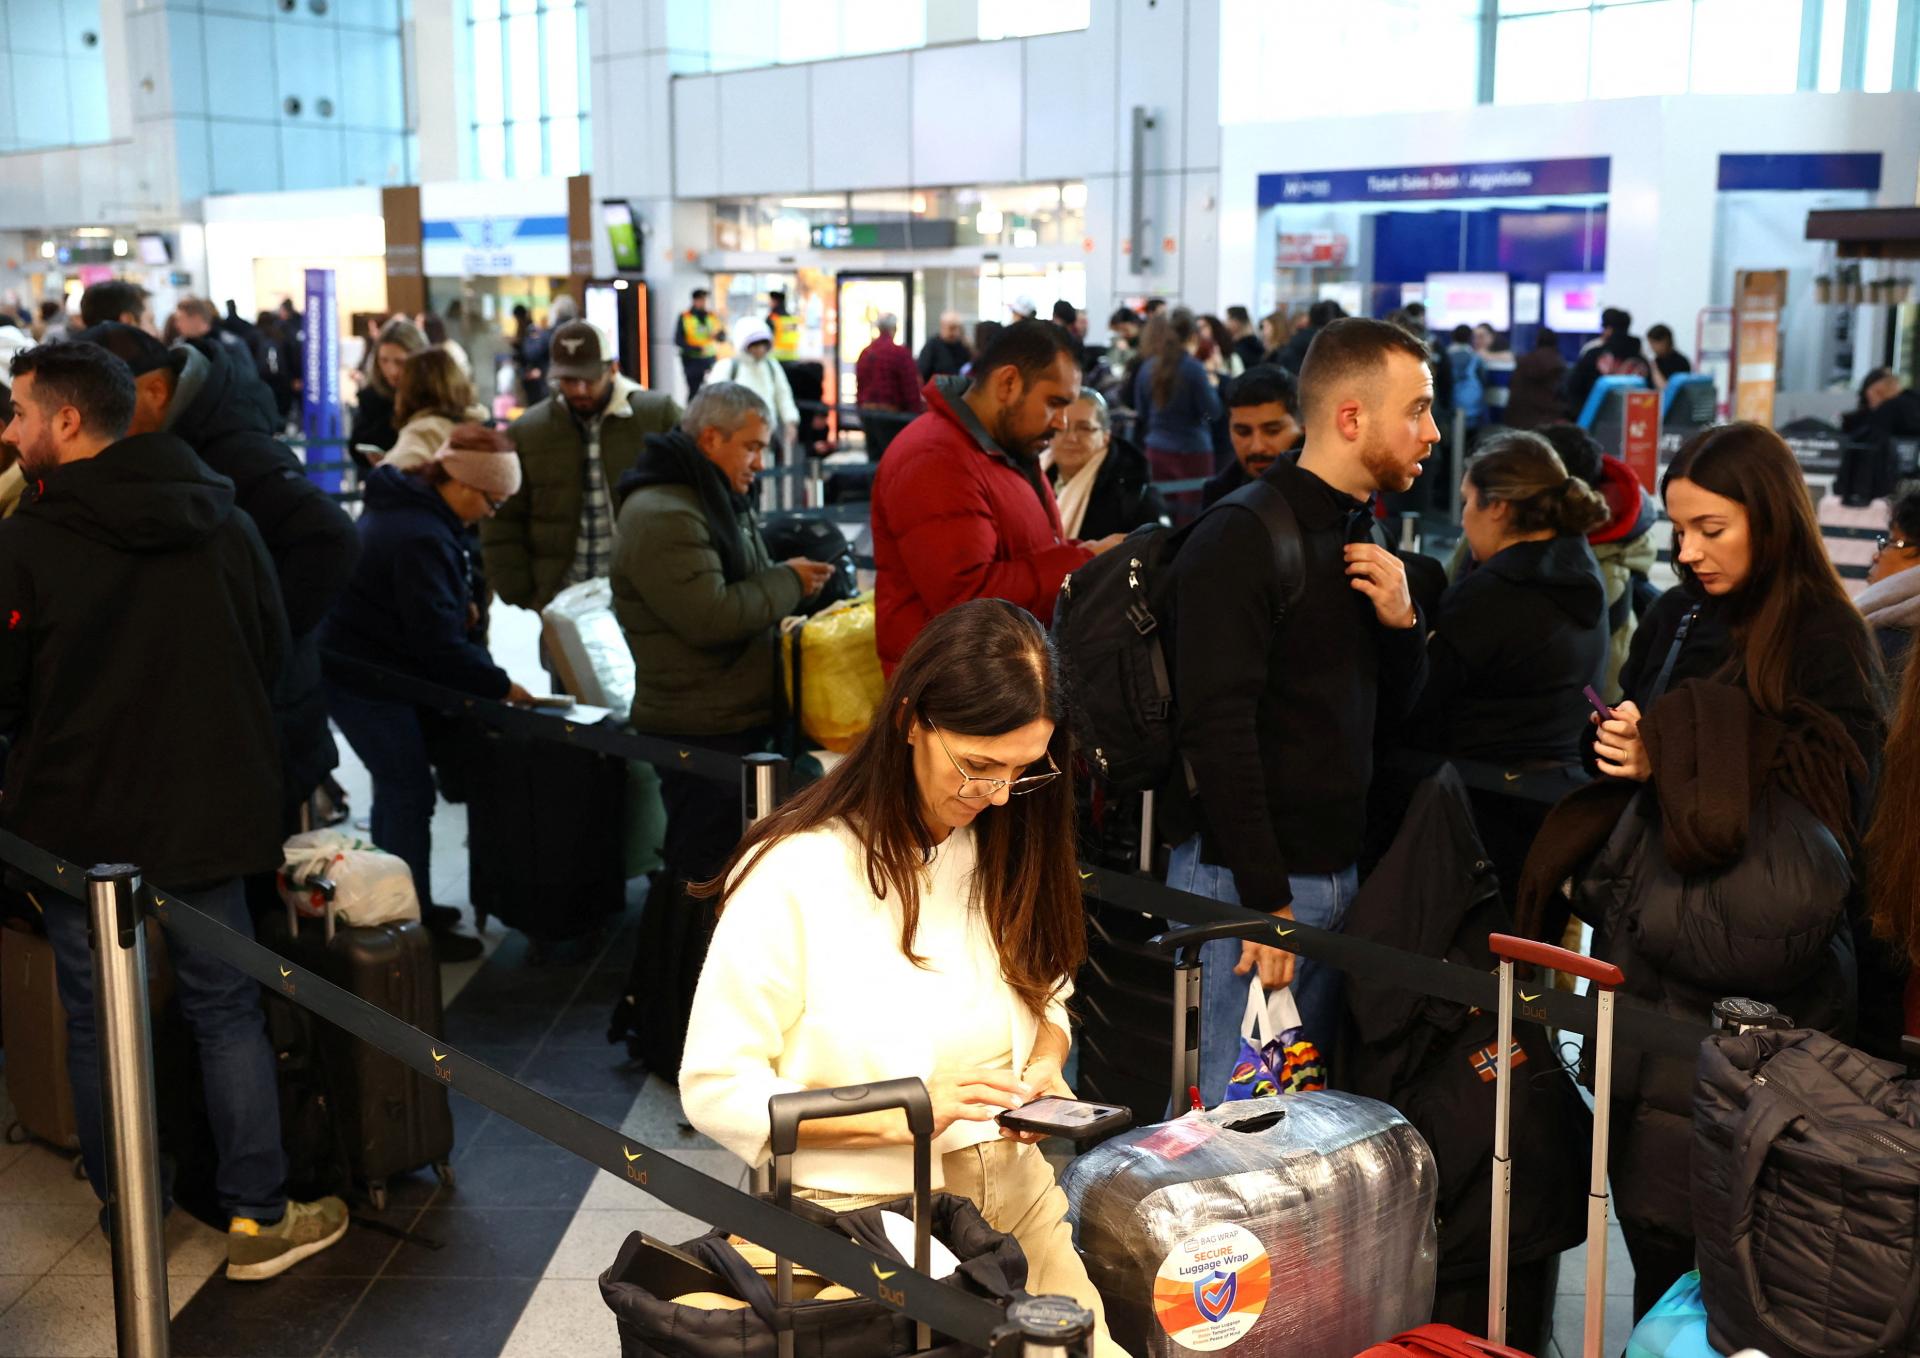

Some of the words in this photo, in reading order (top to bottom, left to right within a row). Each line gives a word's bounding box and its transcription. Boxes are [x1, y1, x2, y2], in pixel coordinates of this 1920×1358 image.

[1522, 1002, 1547, 1020] bud
[434, 1060, 452, 1082] bud
[627, 1161, 647, 1185] bud
[1200, 1235, 1217, 1246] BAG
[1217, 1230, 1239, 1241] WRAP
[1179, 1259, 1222, 1275] Luggage
[1223, 1253, 1249, 1265] Wrap
[1194, 1245, 1233, 1262] SECURE
[878, 1280, 905, 1307] bud
